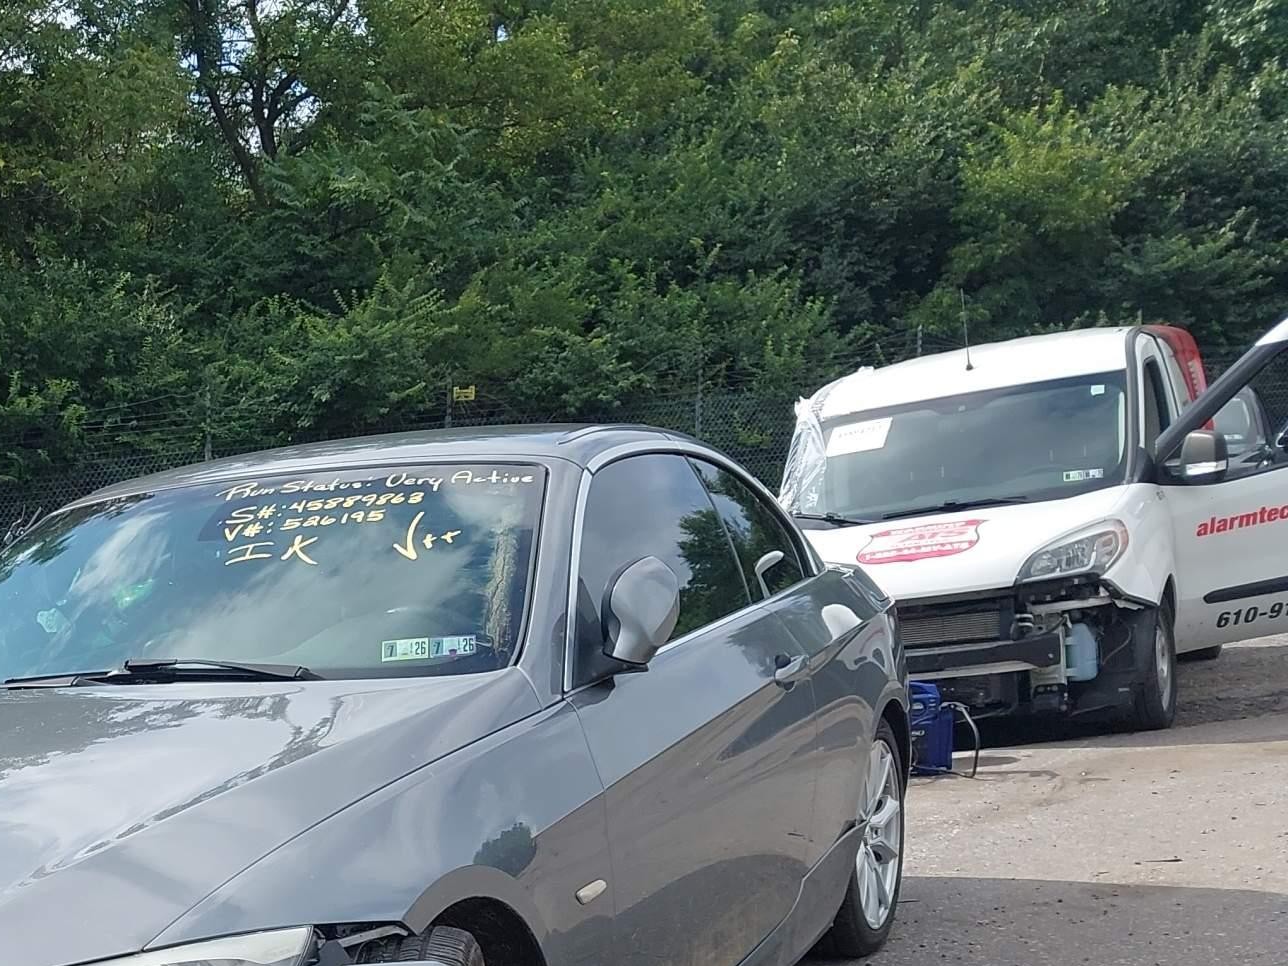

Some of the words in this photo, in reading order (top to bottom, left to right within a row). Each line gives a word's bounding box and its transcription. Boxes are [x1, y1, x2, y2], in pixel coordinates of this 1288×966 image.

[216, 482, 275, 501] Run
[280, 477, 374, 493] Status:
[385, 473, 443, 491] Very
[451, 470, 534, 484] Active
[288, 491, 425, 513] 45889863
[279, 508, 387, 531] 526195
[280, 534, 319, 566] K
[414, 641, 427, 655] 26
[462, 637, 474, 652] 26
